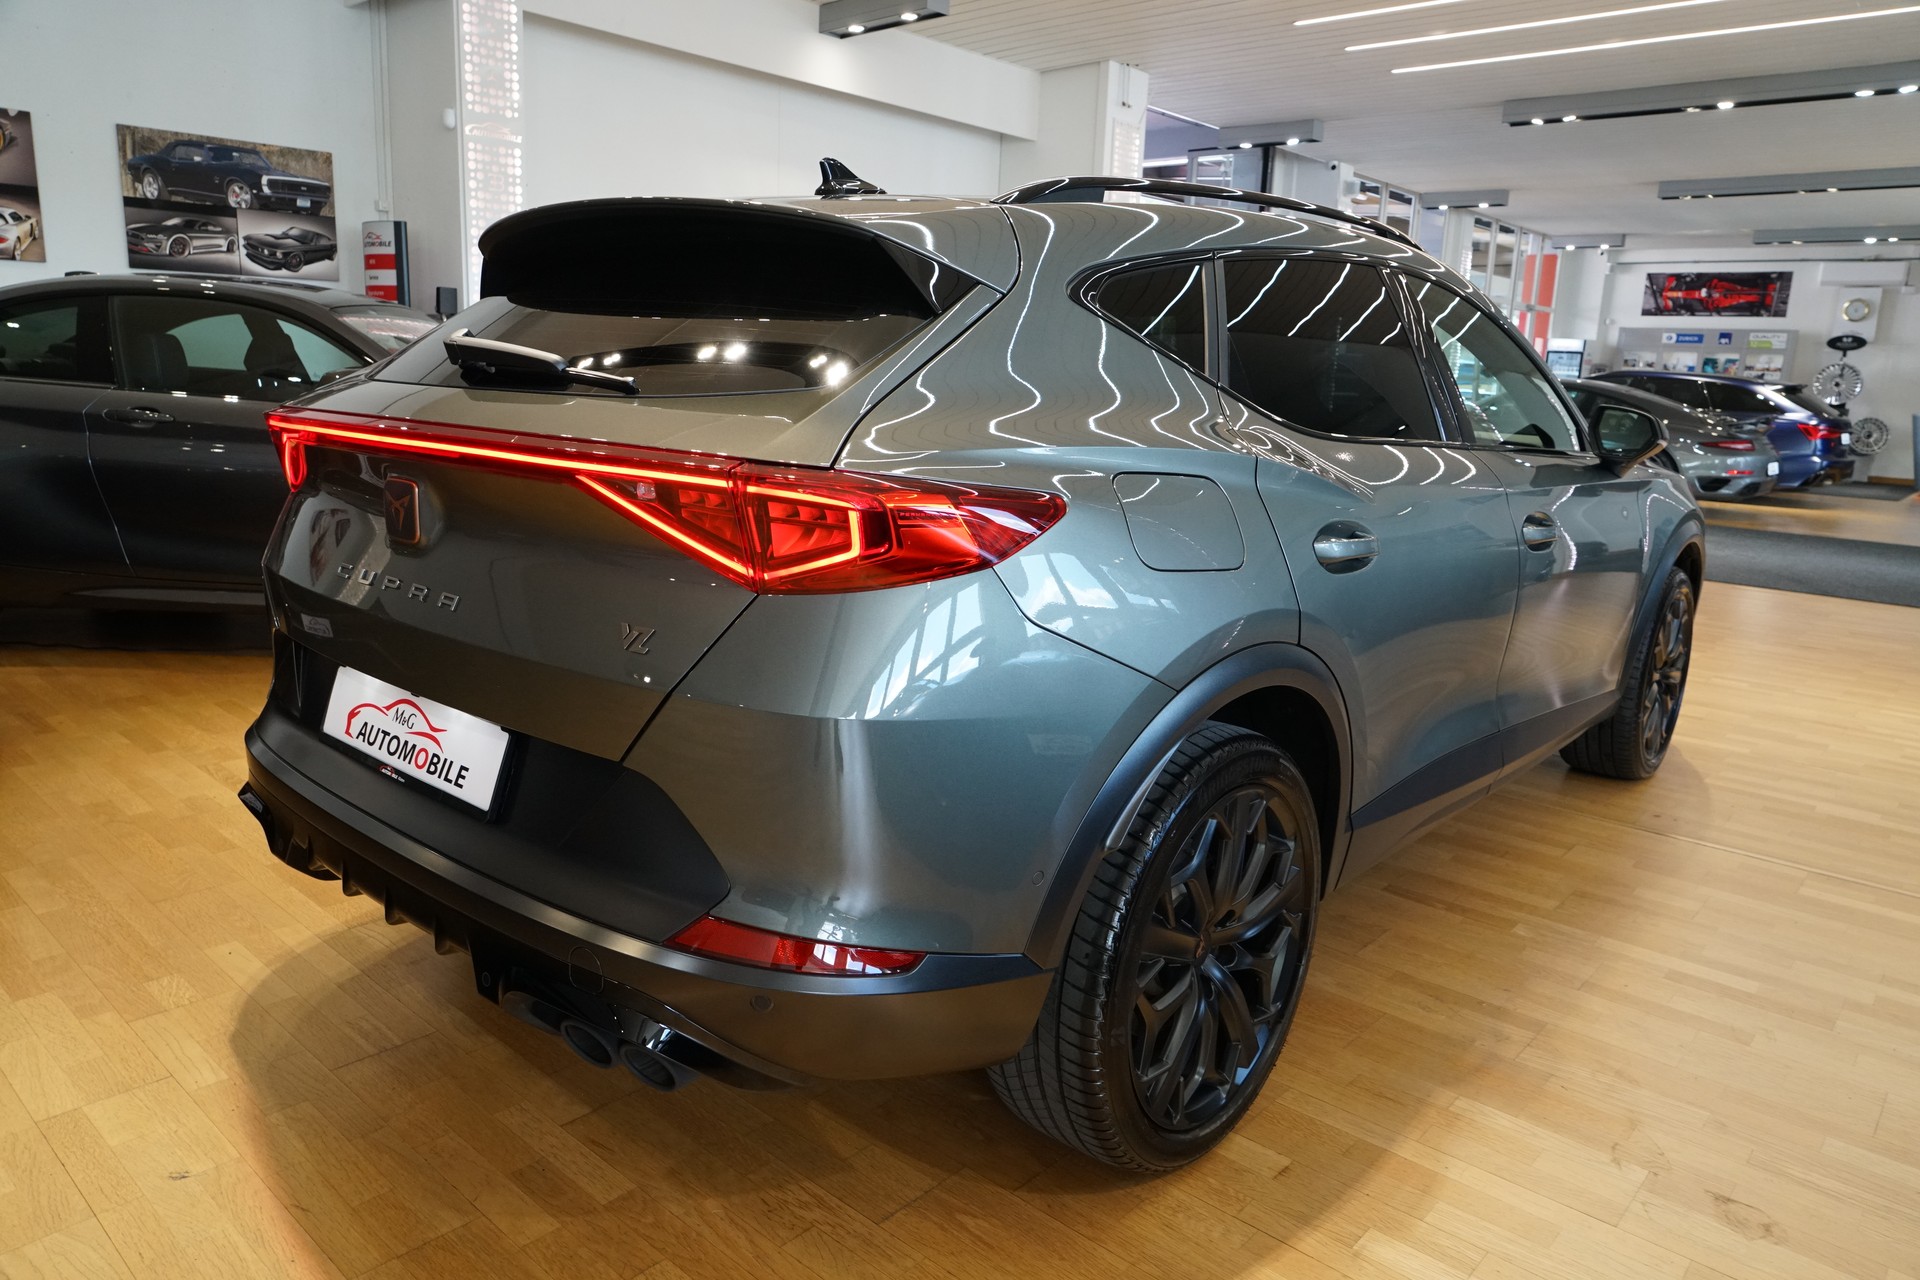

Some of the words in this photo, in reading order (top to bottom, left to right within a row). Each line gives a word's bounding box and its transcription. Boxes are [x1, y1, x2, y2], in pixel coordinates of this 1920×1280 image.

[337, 562, 460, 611] CUPRA
[392, 707, 417, 730] M&G
[356, 721, 470, 790] AUTOMOBILE
